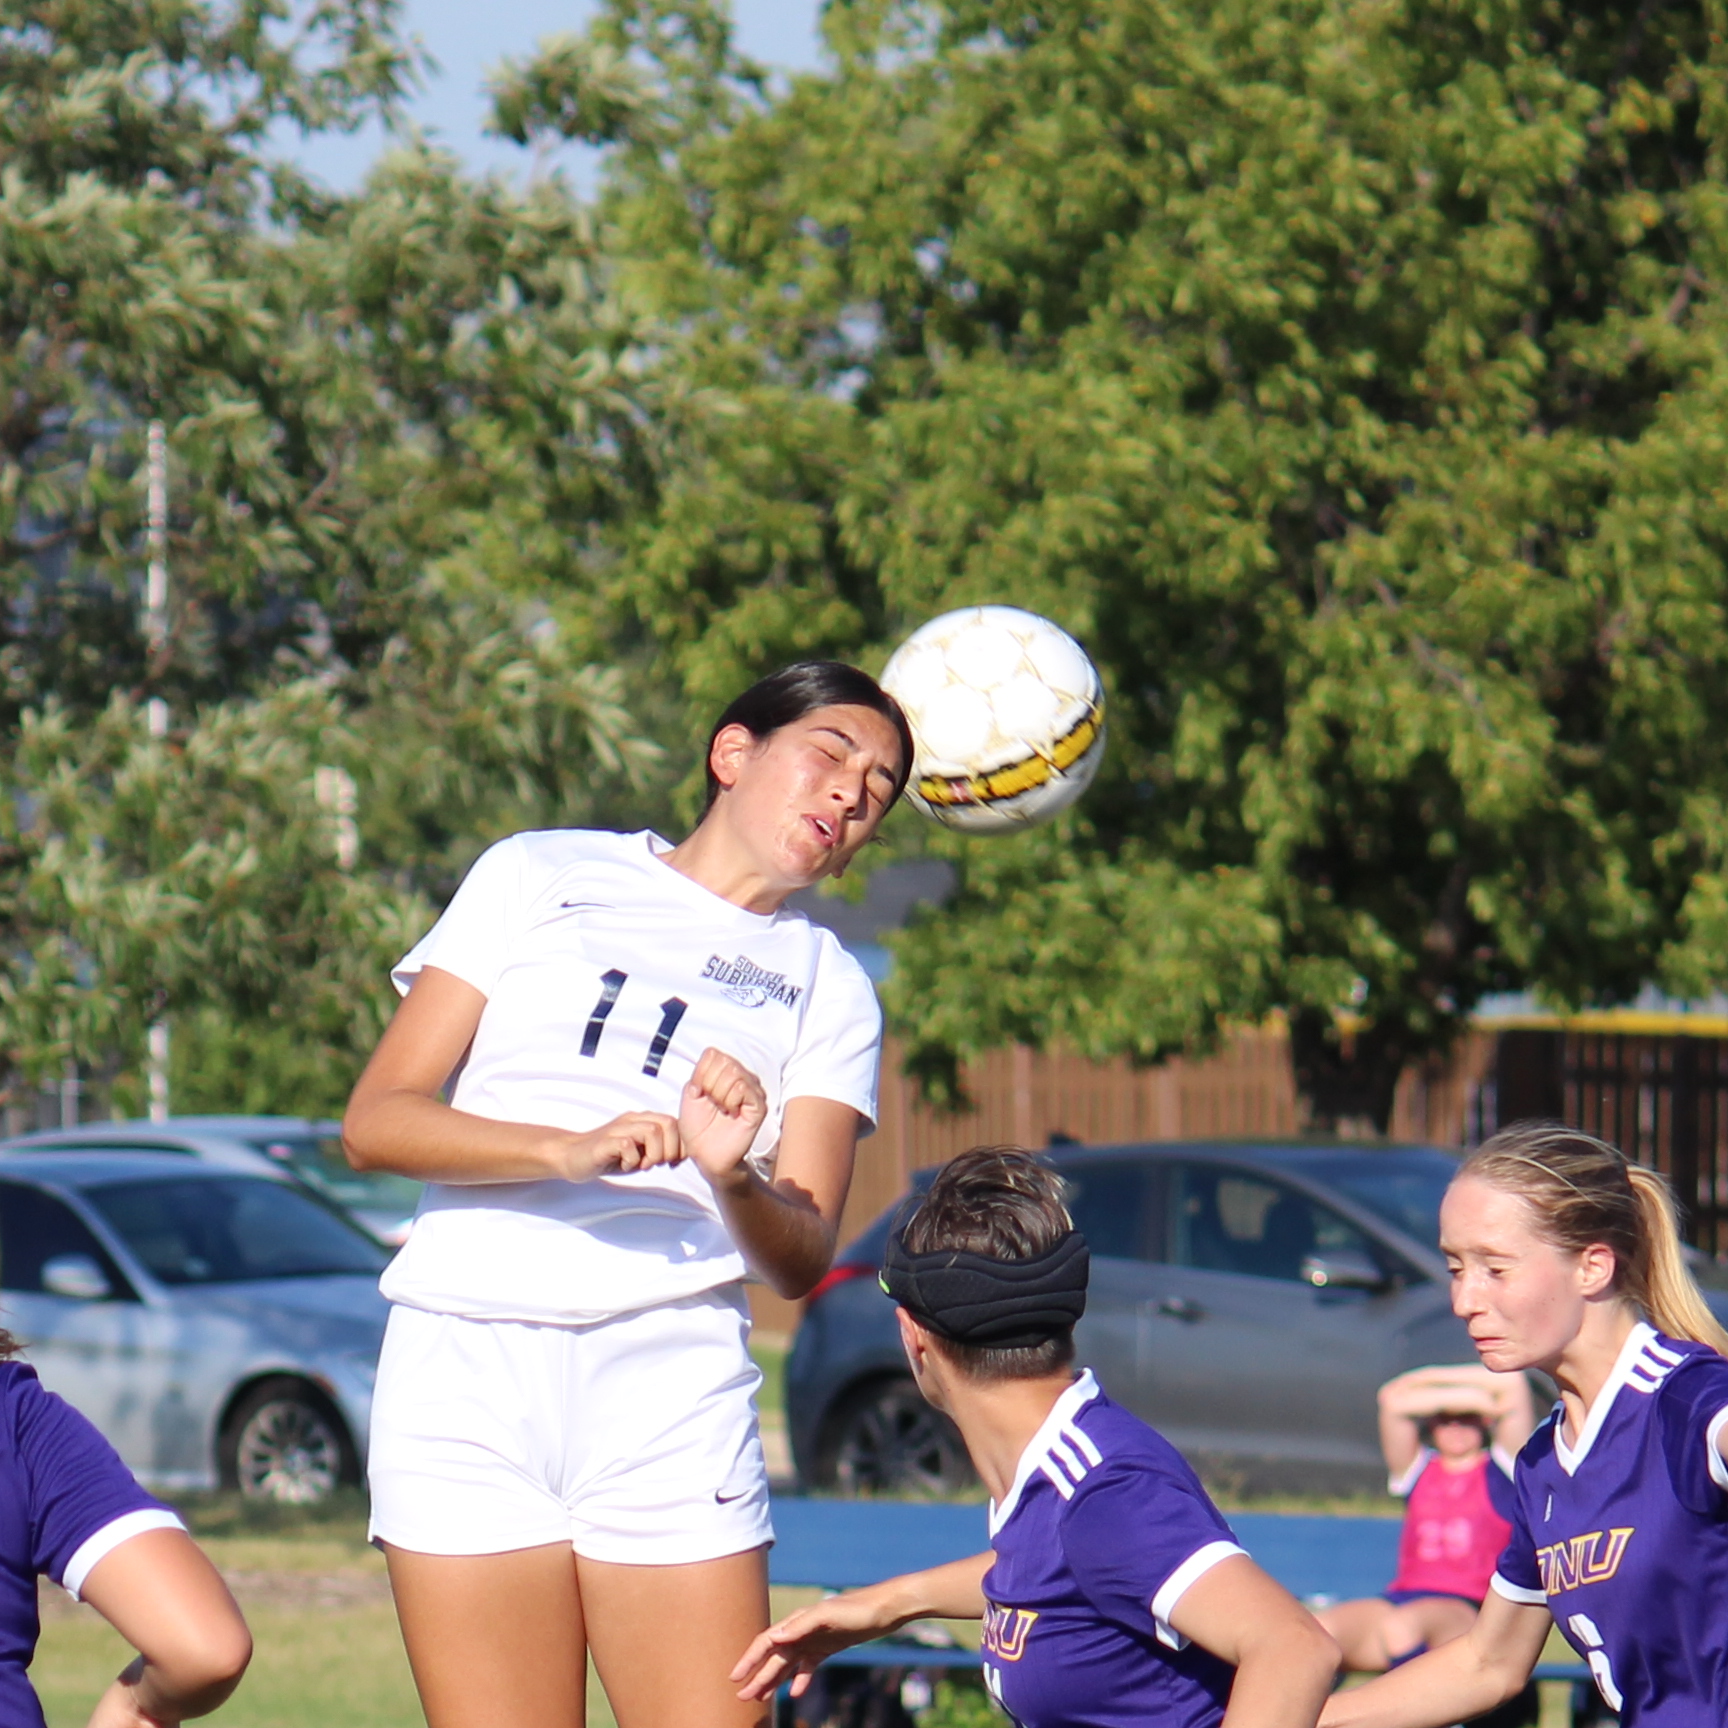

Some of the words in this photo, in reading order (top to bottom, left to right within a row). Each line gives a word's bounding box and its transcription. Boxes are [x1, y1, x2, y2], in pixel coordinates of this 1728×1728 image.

[699, 953, 804, 1011] SUBURBAN
[734, 954, 787, 983] SOUTH
[579, 968, 689, 1078] 11
